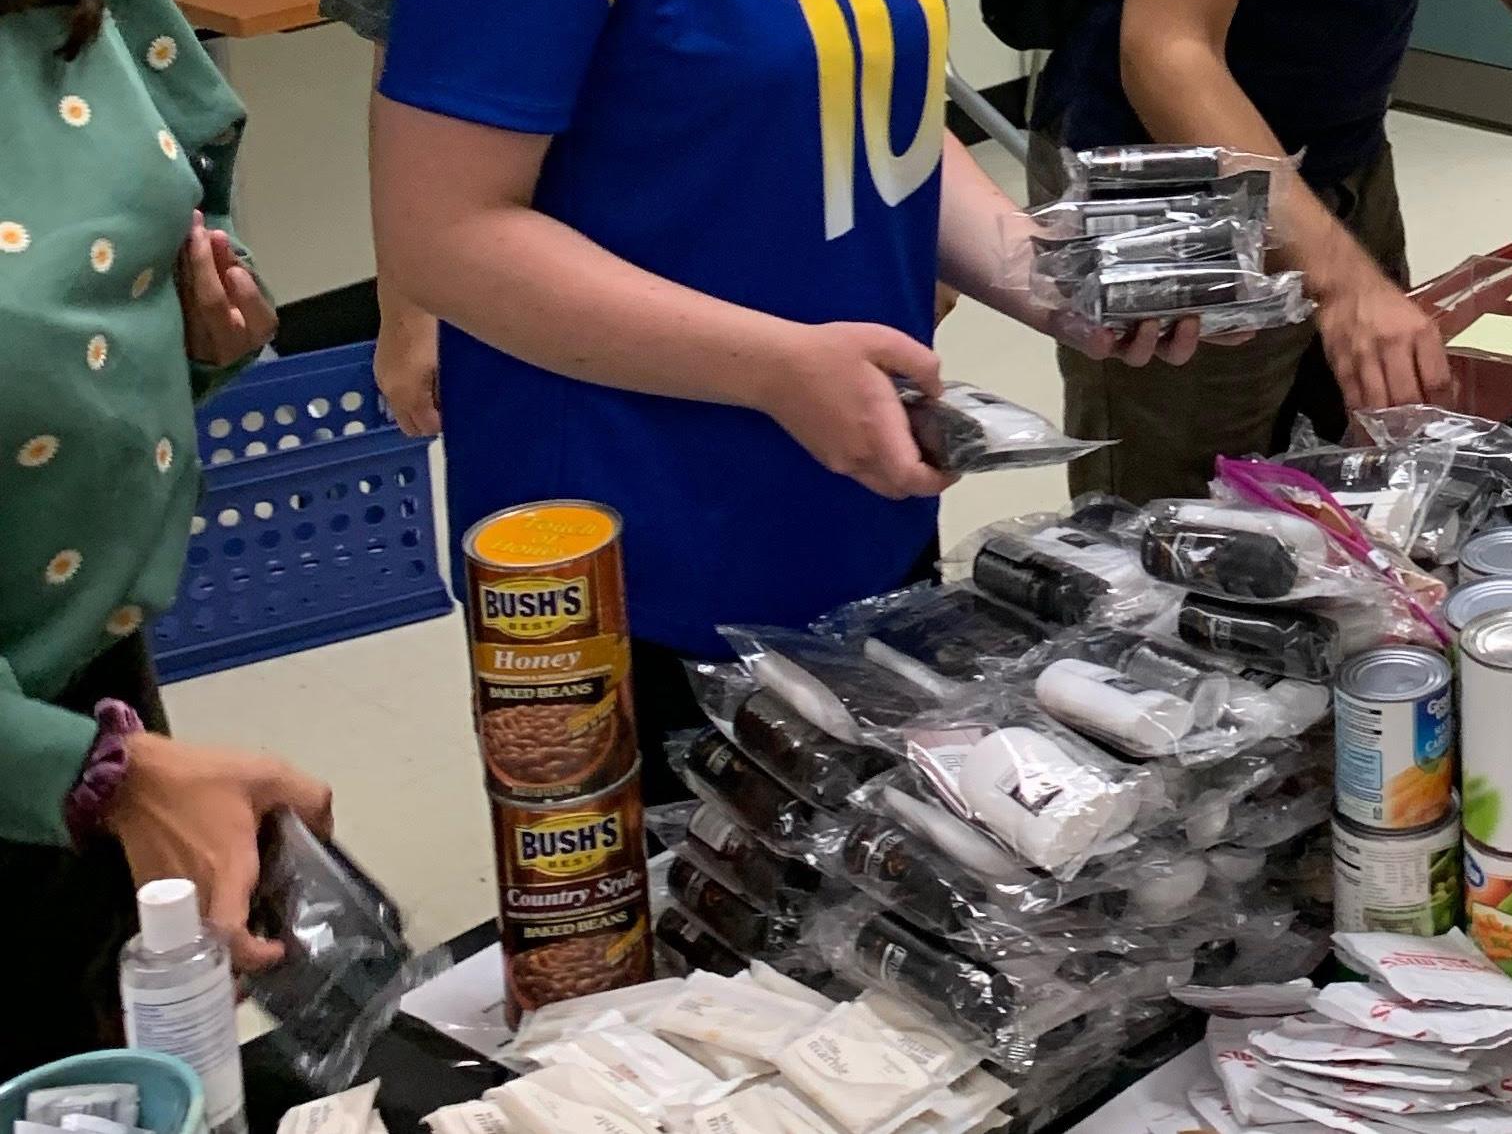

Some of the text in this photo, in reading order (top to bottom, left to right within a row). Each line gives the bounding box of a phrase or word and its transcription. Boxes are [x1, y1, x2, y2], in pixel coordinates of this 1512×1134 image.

[485, 585, 582, 618] BUSH'S
[494, 650, 582, 671] Honey
[489, 682, 594, 699] BAKED BEANS
[522, 816, 618, 860] BUSH'S
[507, 888, 591, 907] Country
